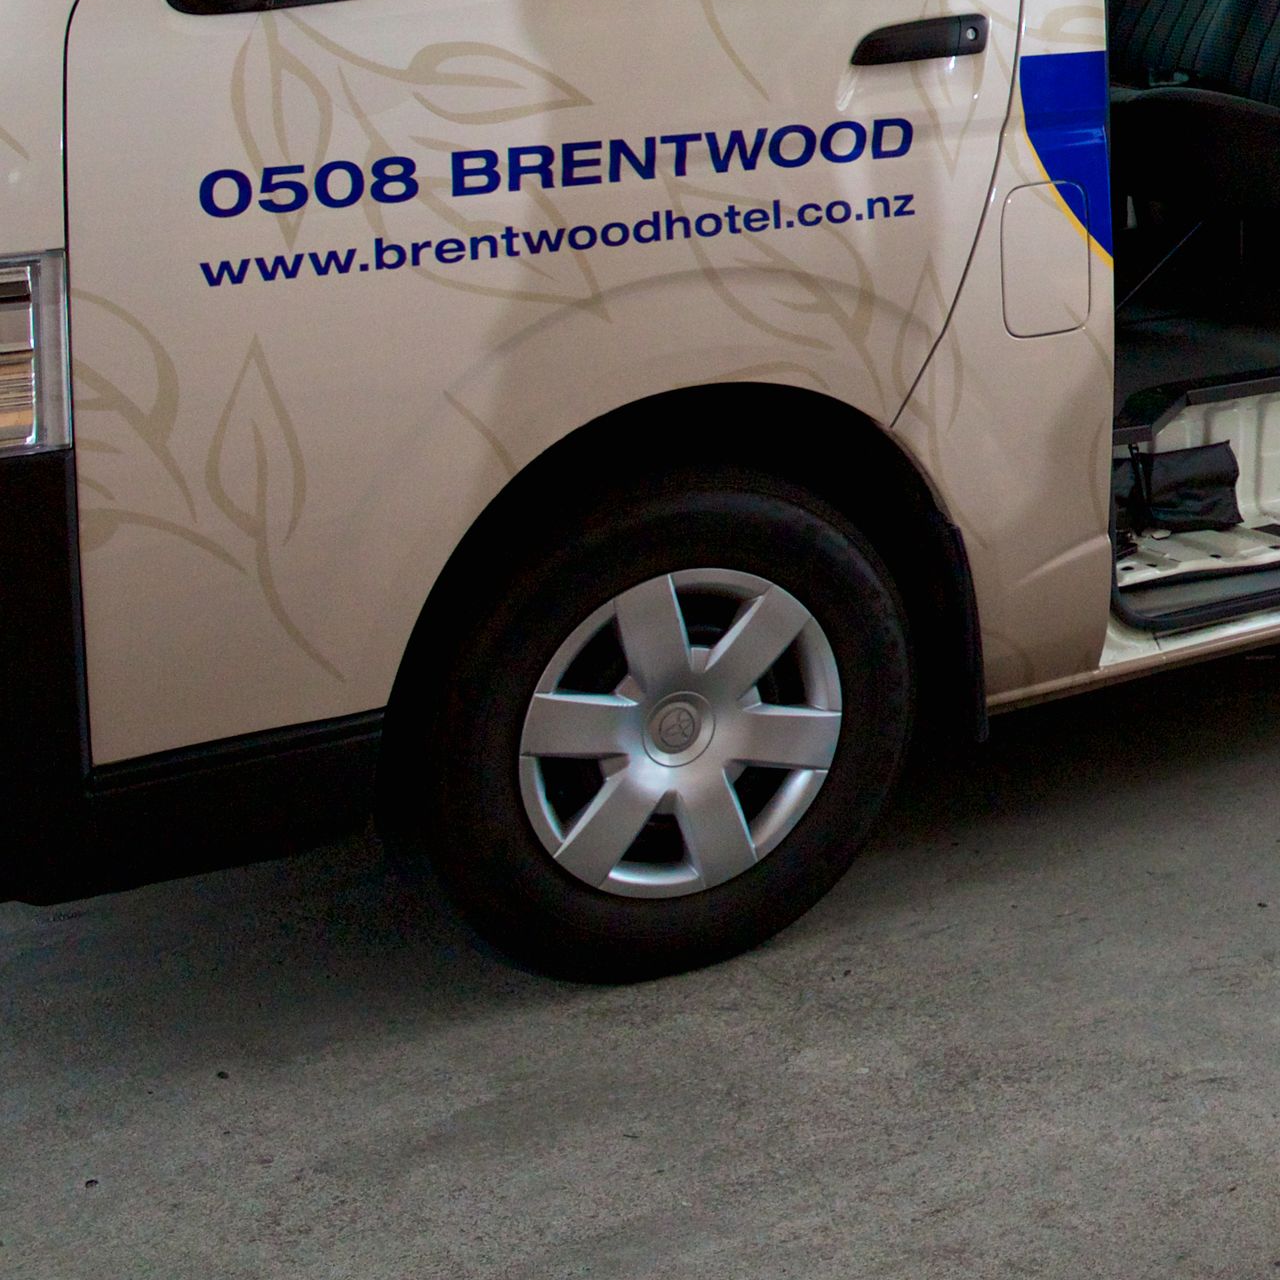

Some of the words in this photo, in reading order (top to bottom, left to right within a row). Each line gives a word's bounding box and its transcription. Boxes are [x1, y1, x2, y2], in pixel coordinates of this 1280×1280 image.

[199, 156, 419, 218] 0508
[450, 117, 914, 197] BRENTWOOD
[200, 188, 917, 287] www.brentwoodhotel.co.nz
